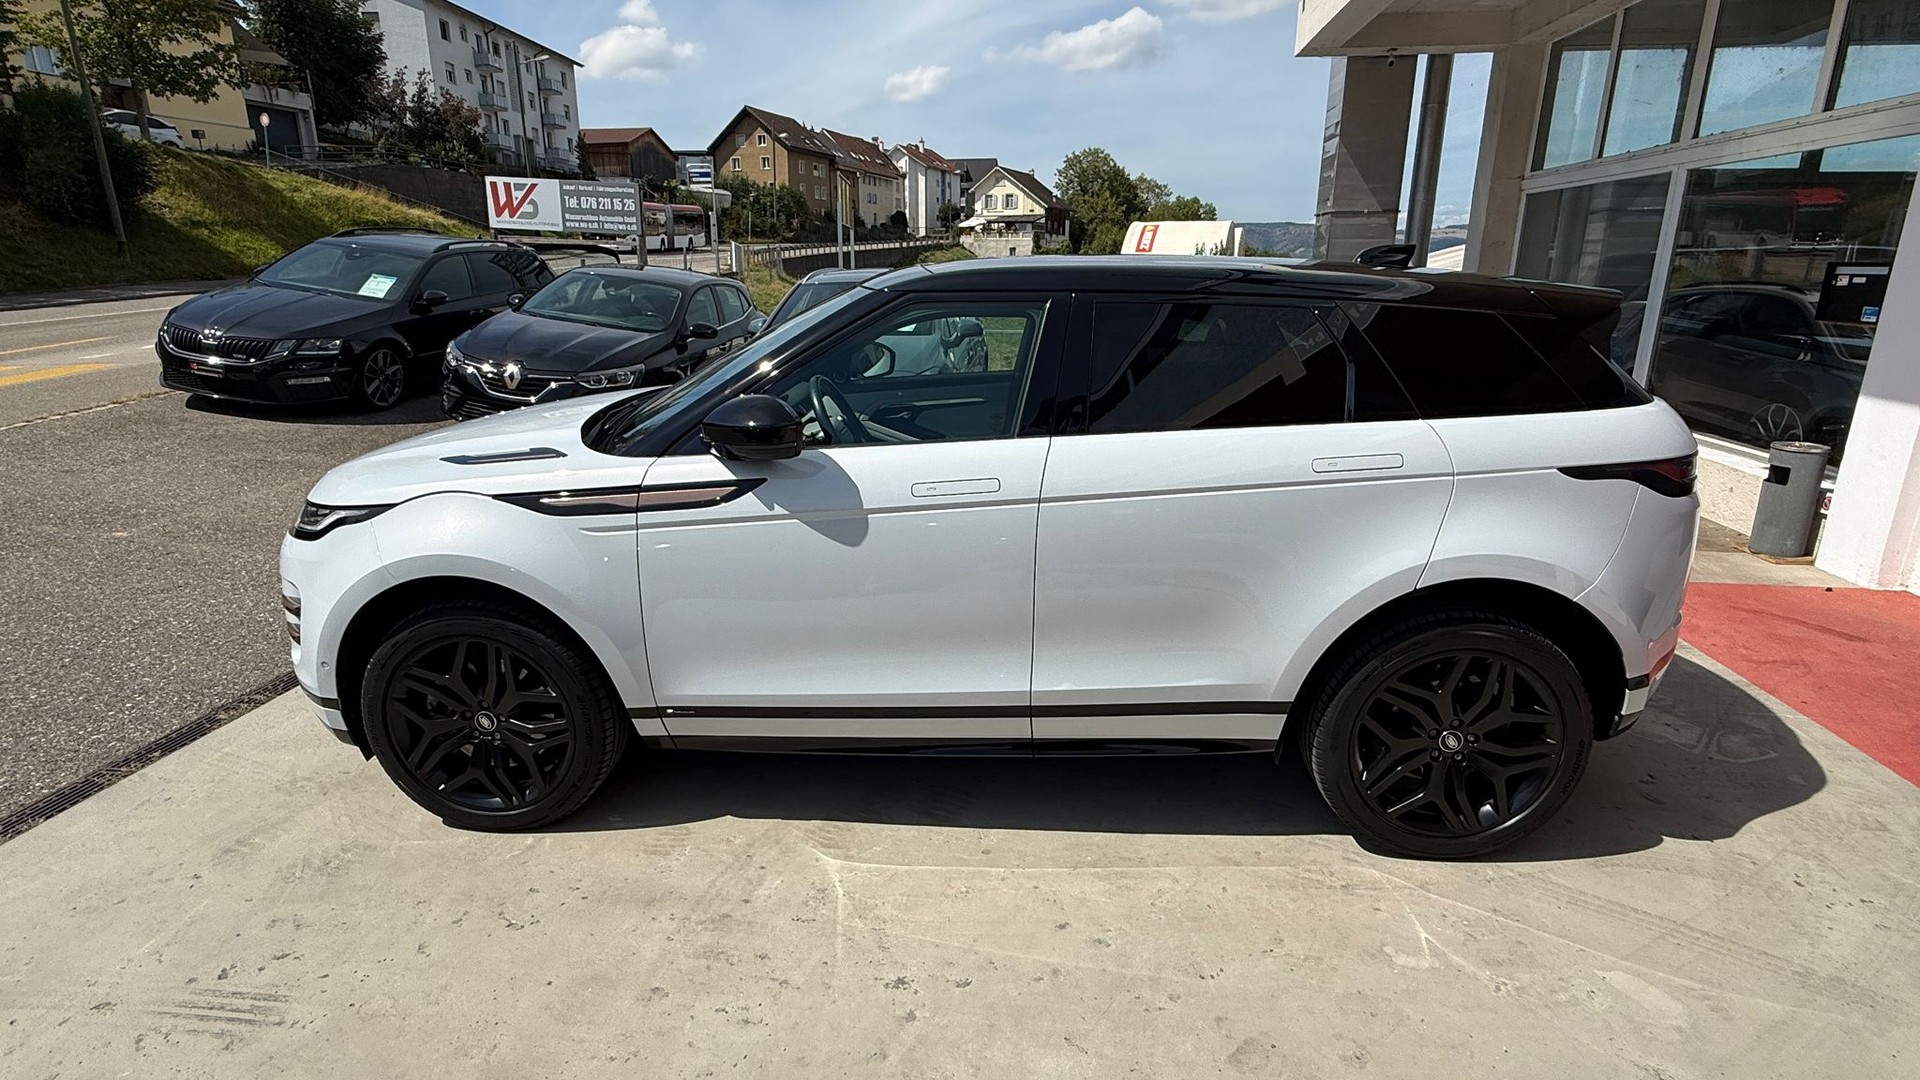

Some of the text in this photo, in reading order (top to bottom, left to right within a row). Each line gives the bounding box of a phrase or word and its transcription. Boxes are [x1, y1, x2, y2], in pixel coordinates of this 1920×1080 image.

[580, 196, 598, 209] 076
[598, 197, 612, 210] 211
[613, 198, 623, 211] 15
[623, 198, 635, 211] 25
